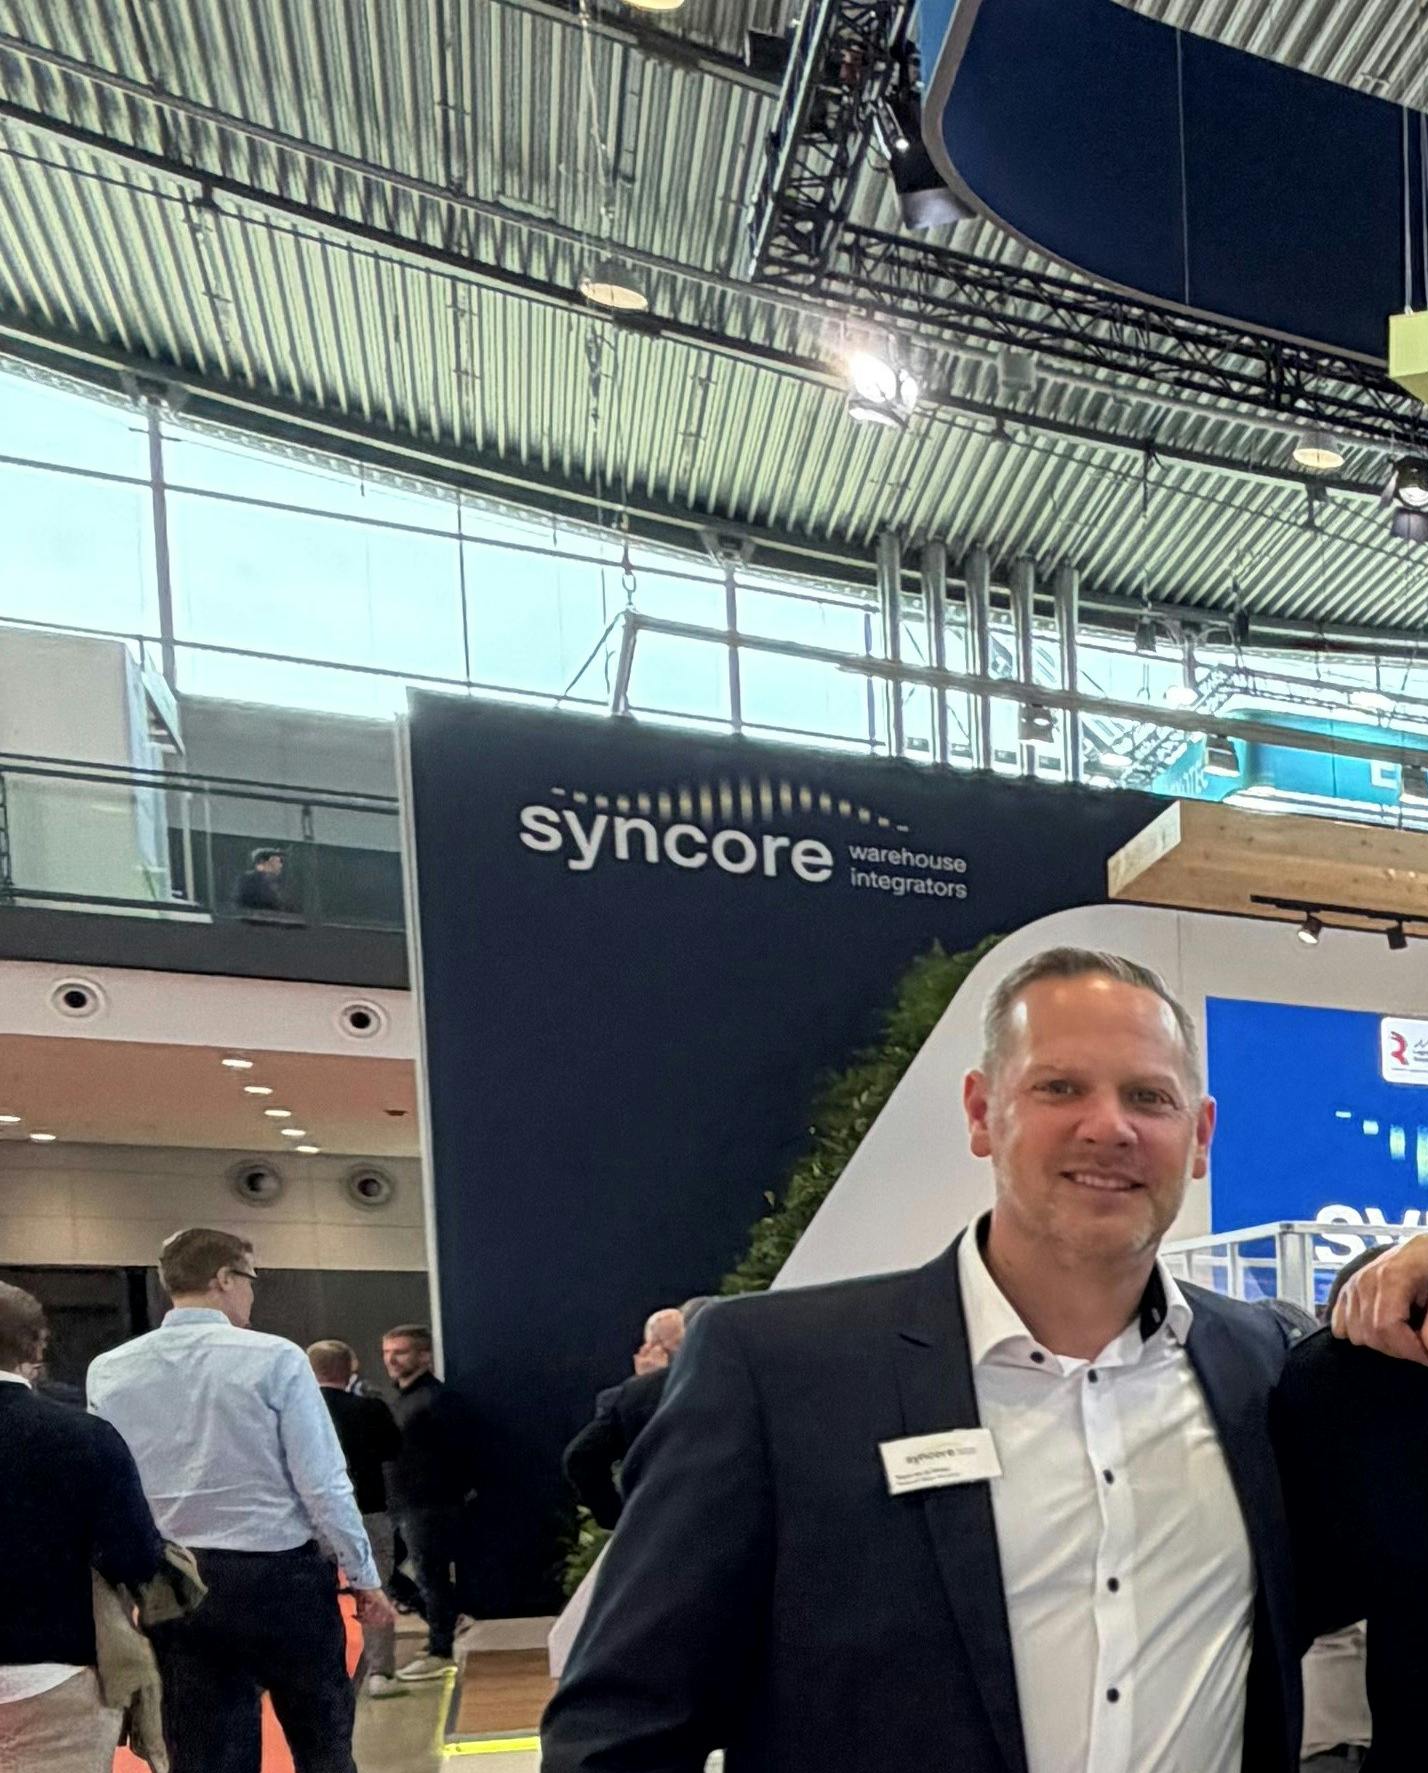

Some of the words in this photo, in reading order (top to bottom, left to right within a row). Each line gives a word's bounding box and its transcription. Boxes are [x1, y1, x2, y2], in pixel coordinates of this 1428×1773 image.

[519, 805, 834, 882] syncore
[848, 845, 967, 873] warehouse
[850, 867, 968, 899] integrators
